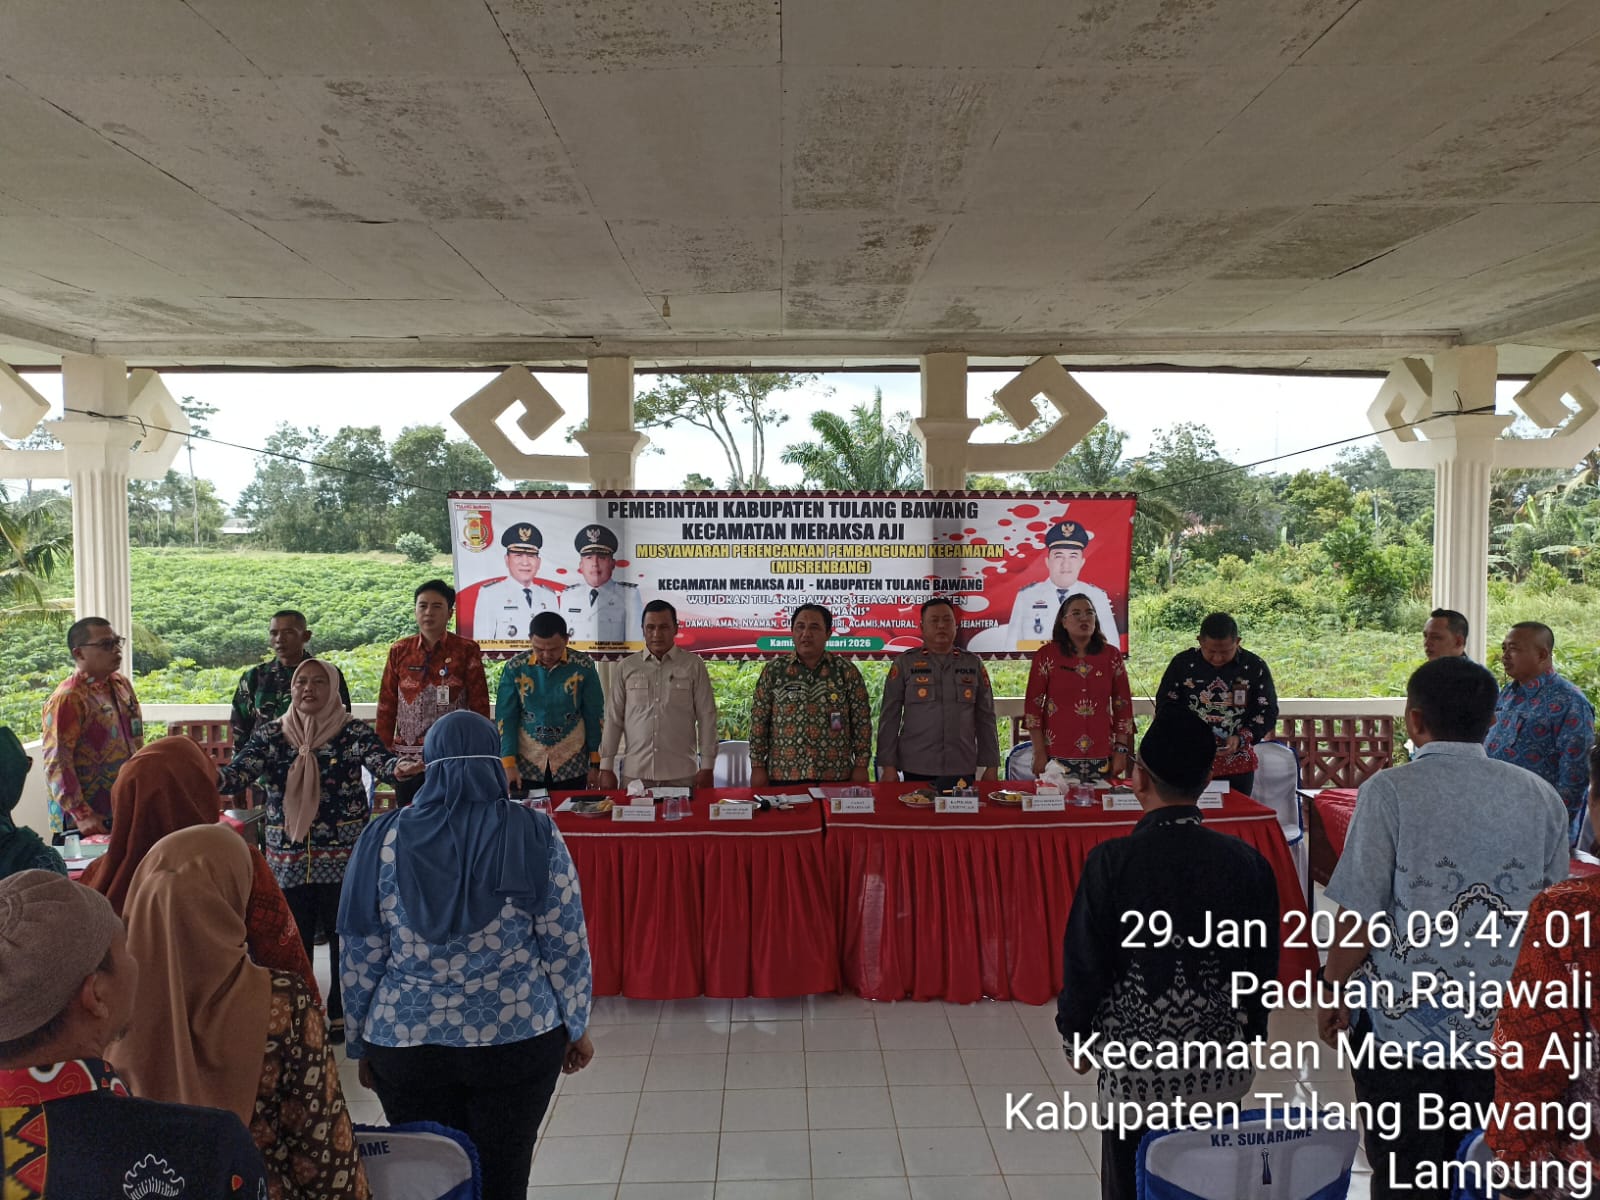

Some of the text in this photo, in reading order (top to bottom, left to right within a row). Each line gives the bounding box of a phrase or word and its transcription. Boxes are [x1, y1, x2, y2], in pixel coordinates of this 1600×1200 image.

[607, 501, 979, 519] PEMERINTAH KABUPATEN TULANG BAWANG
[682, 523, 905, 540] KECAMATAN MERAKSA AJI
[636, 544, 1005, 558] MUSYAWARAH PERENCANAAN PEMBANGUNAN KECAMATAN
[770, 560, 872, 574] (MUSRENBANG)
[658, 578, 727, 591] KECAMATAN
[729, 578, 784, 591] MERAKSA
[787, 578, 804, 591] AJI
[816, 578, 882, 591] KABUPATEN
[885, 578, 930, 591] TULANG
[931, 578, 983, 591] BAWANG
[686, 594, 968, 605] WUJUDKAN TULANG BAWANG SEBAGAI KABUTEN
[960, 619, 999, 629] SEJAHTERA
[826, 638, 846, 647] uari
[848, 638, 871, 647] 2026
[1210, 1126, 1313, 1147] KP. SUKARAME
